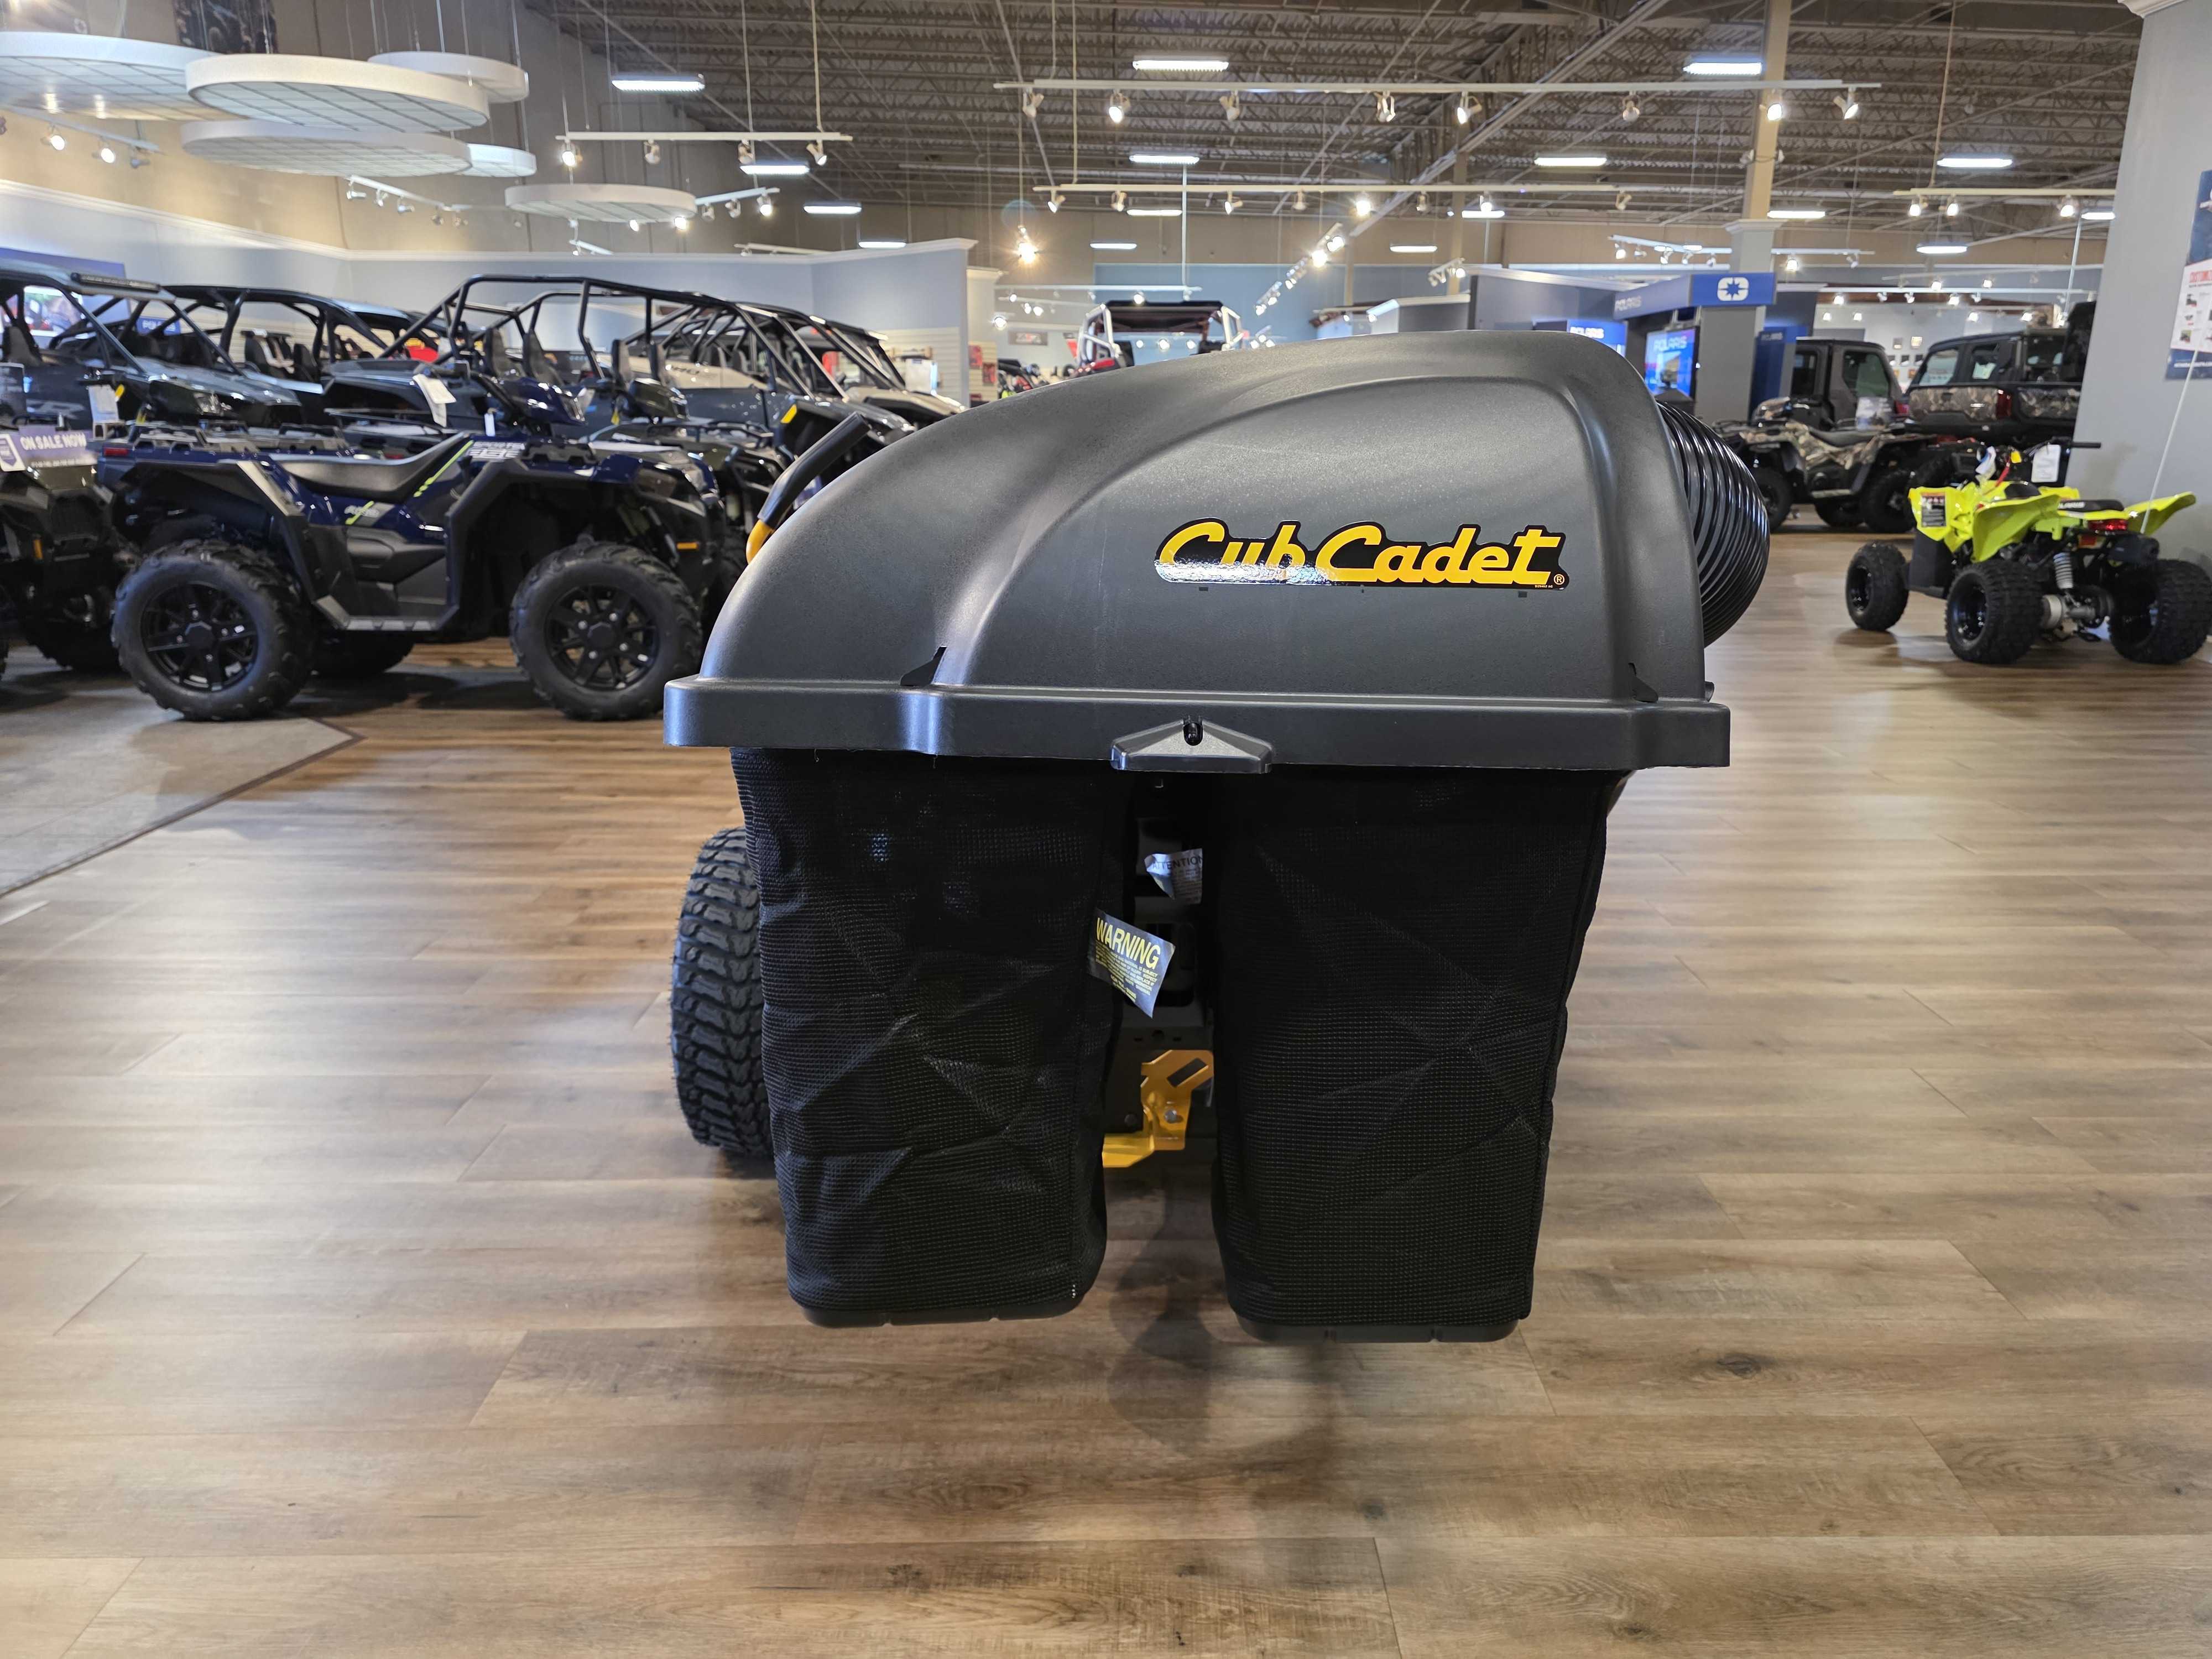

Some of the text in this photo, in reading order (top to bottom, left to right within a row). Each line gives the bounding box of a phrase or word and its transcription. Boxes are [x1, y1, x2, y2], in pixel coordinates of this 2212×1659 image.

[20, 436, 36, 450] ON
[35, 435, 63, 449] SALE
[62, 433, 87, 447] NOW
[1159, 521, 1561, 585] Cub Cadet
[1096, 917, 1161, 969] WARNING
